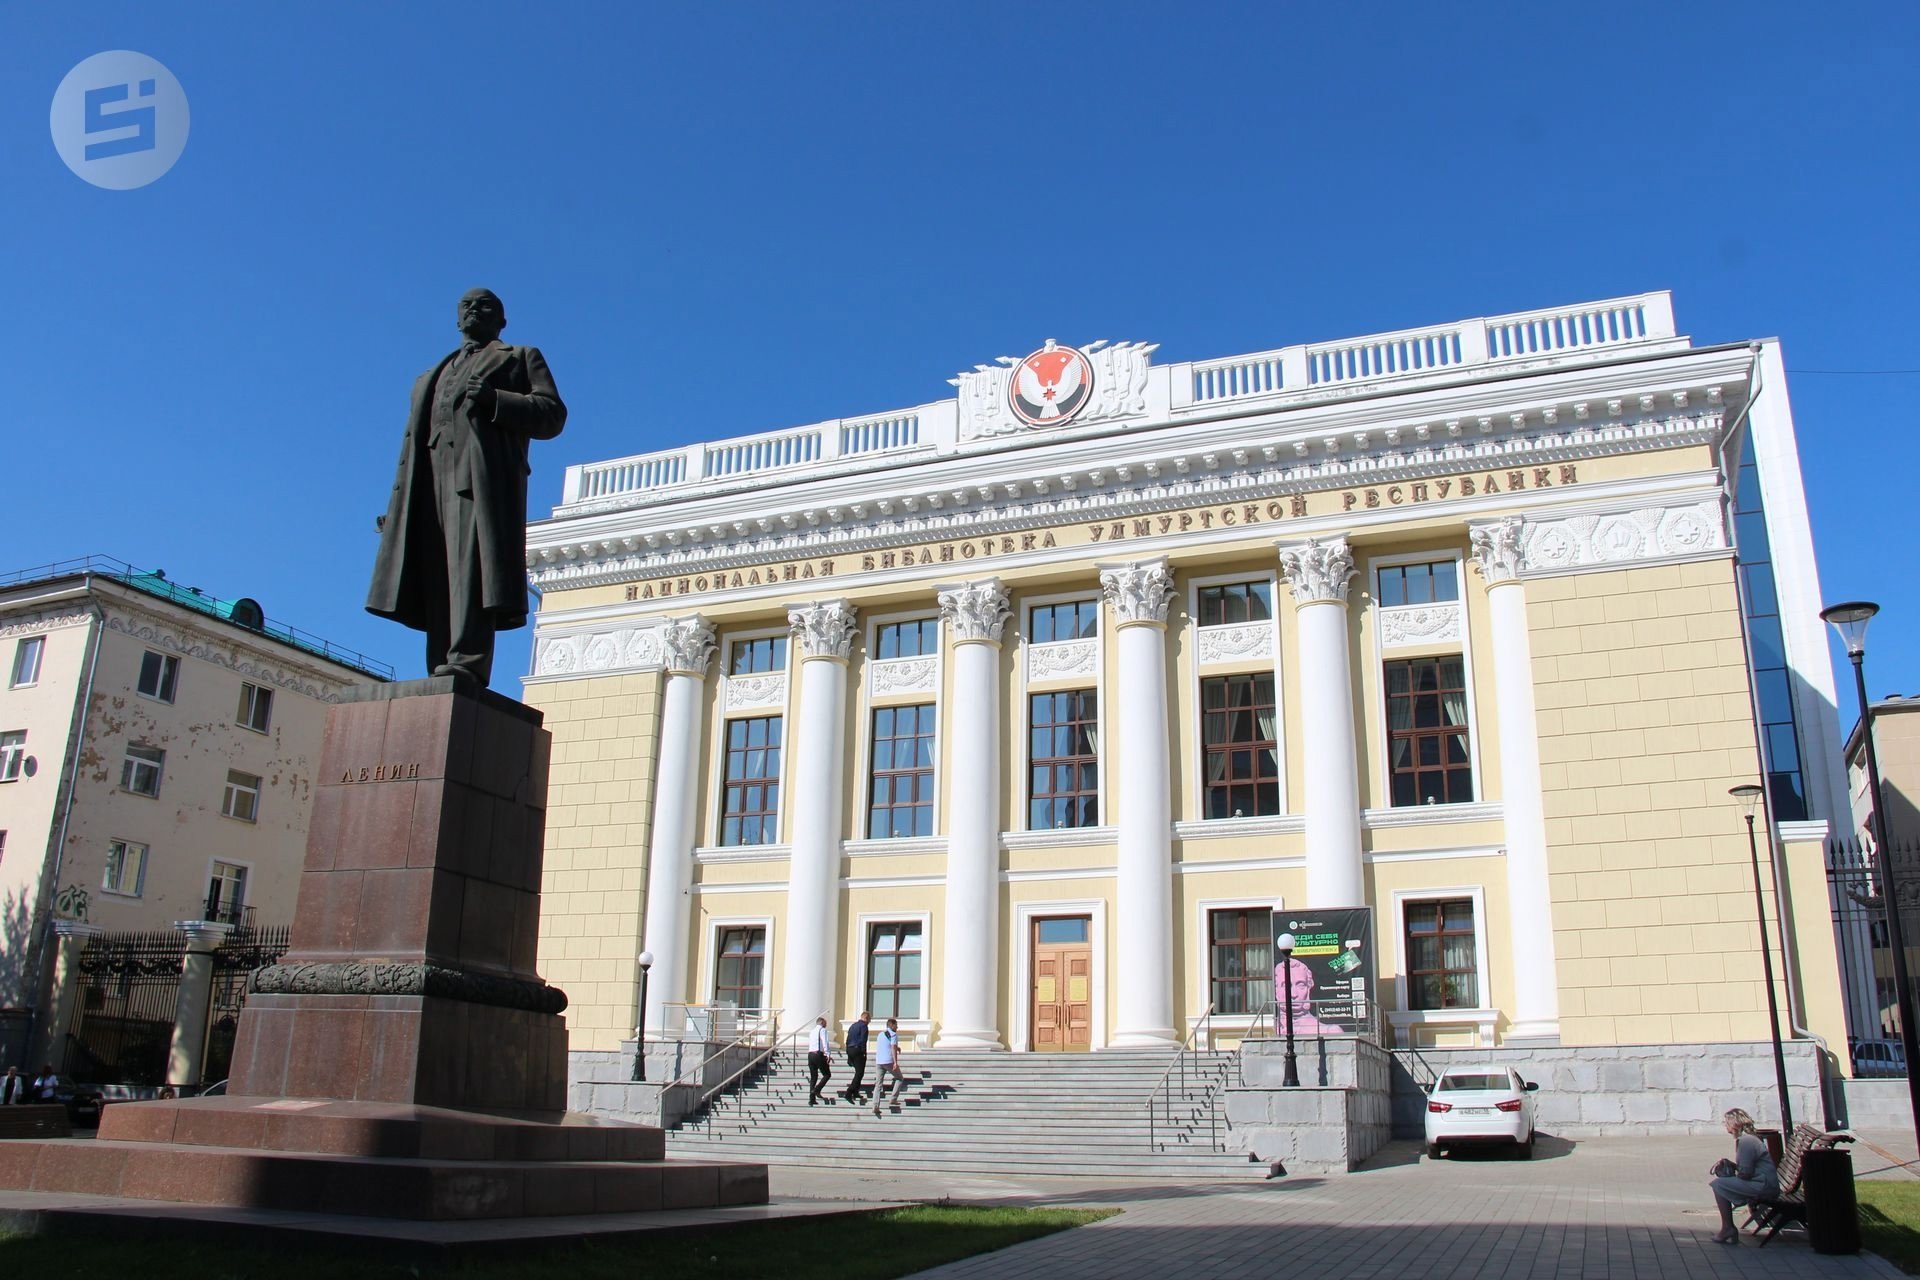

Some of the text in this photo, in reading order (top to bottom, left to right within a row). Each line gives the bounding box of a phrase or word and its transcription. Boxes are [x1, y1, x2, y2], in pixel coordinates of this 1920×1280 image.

[624, 463, 1579, 601] НАЦИОНАЛЬНАЯ БИБЛИОТЕКА УДМУРТСКОЙ РЕСПУБЛИКИ
[340, 763, 420, 783] ЛЕНИН
